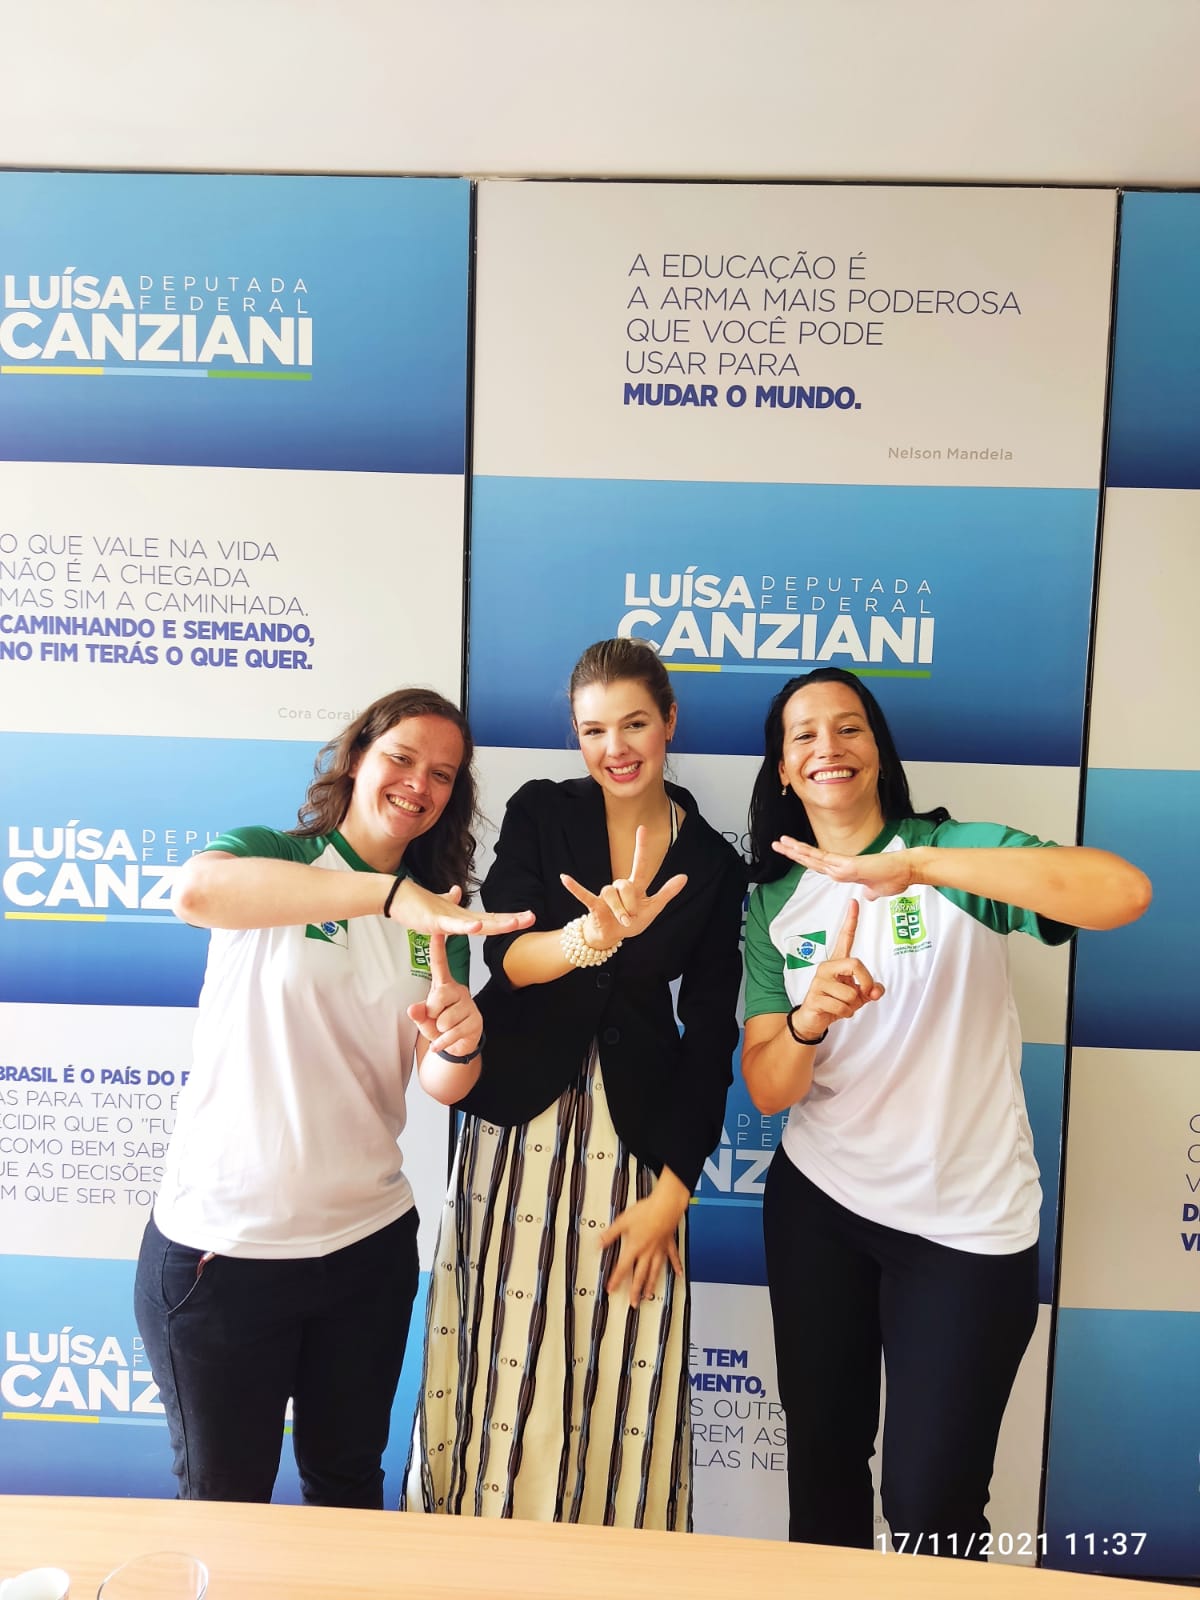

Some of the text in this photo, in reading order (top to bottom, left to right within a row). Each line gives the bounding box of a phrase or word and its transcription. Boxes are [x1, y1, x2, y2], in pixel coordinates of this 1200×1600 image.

[628, 250, 867, 283] A EDUCAÇÃO É
[4, 267, 134, 310] LUÍSA
[139, 275, 309, 294] DEPUTADA
[139, 295, 309, 314] FEDERAL
[627, 286, 1022, 315] A ARMA MAIS PODEROSA
[0, 312, 313, 366] CANZIANI
[626, 316, 884, 346] QUE VOCÊ PODE
[625, 351, 800, 376] USAR PARA
[623, 383, 862, 410] MUDAR O MUNDO.
[888, 447, 1014, 461] Nelson Mandela
[0, 533, 280, 562] O QUE VALE NA VIDA
[0, 557, 250, 588] NÃO É A CHEGADA
[761, 575, 932, 595] DEPUTADA
[624, 565, 756, 609] LUÍSA
[0, 587, 309, 617] MAS SIM A CAMINHADA.
[760, 595, 931, 614] FEDERAL
[0, 614, 315, 647] CAMINHANDO E SEMEANDO,
[617, 608, 936, 665] CANZIANI
[0, 641, 313, 670] NO FIM TERÁS O QUE QUER.
[278, 707, 312, 719] Cora
[8, 819, 138, 862] LUÍSA
[0, 1066, 58, 1082] BRASIL
[63, 1064, 75, 1083] É
[80, 1068, 95, 1084] O
[100, 1066, 142, 1085] PAÍS
[147, 1070, 175, 1086] DO
[26, 1090, 83, 1108] PARA
[91, 1092, 162, 1110] TANTO
[0, 1113, 56, 1131] CIDIR
[64, 1115, 109, 1133] QUE
[117, 1117, 133, 1134] O
[0, 1137, 63, 1155] COMO
[71, 1139, 115, 1156] BEM
[27, 1162, 54, 1179] AS
[62, 1162, 163, 1183] DECISÕES
[25, 1185, 70, 1203] QUE
[76, 1187, 116, 1204] SER
[6, 1326, 128, 1367] LUÍSA
[702, 1348, 748, 1369] TEM
[754, 1427, 787, 1446] AS
